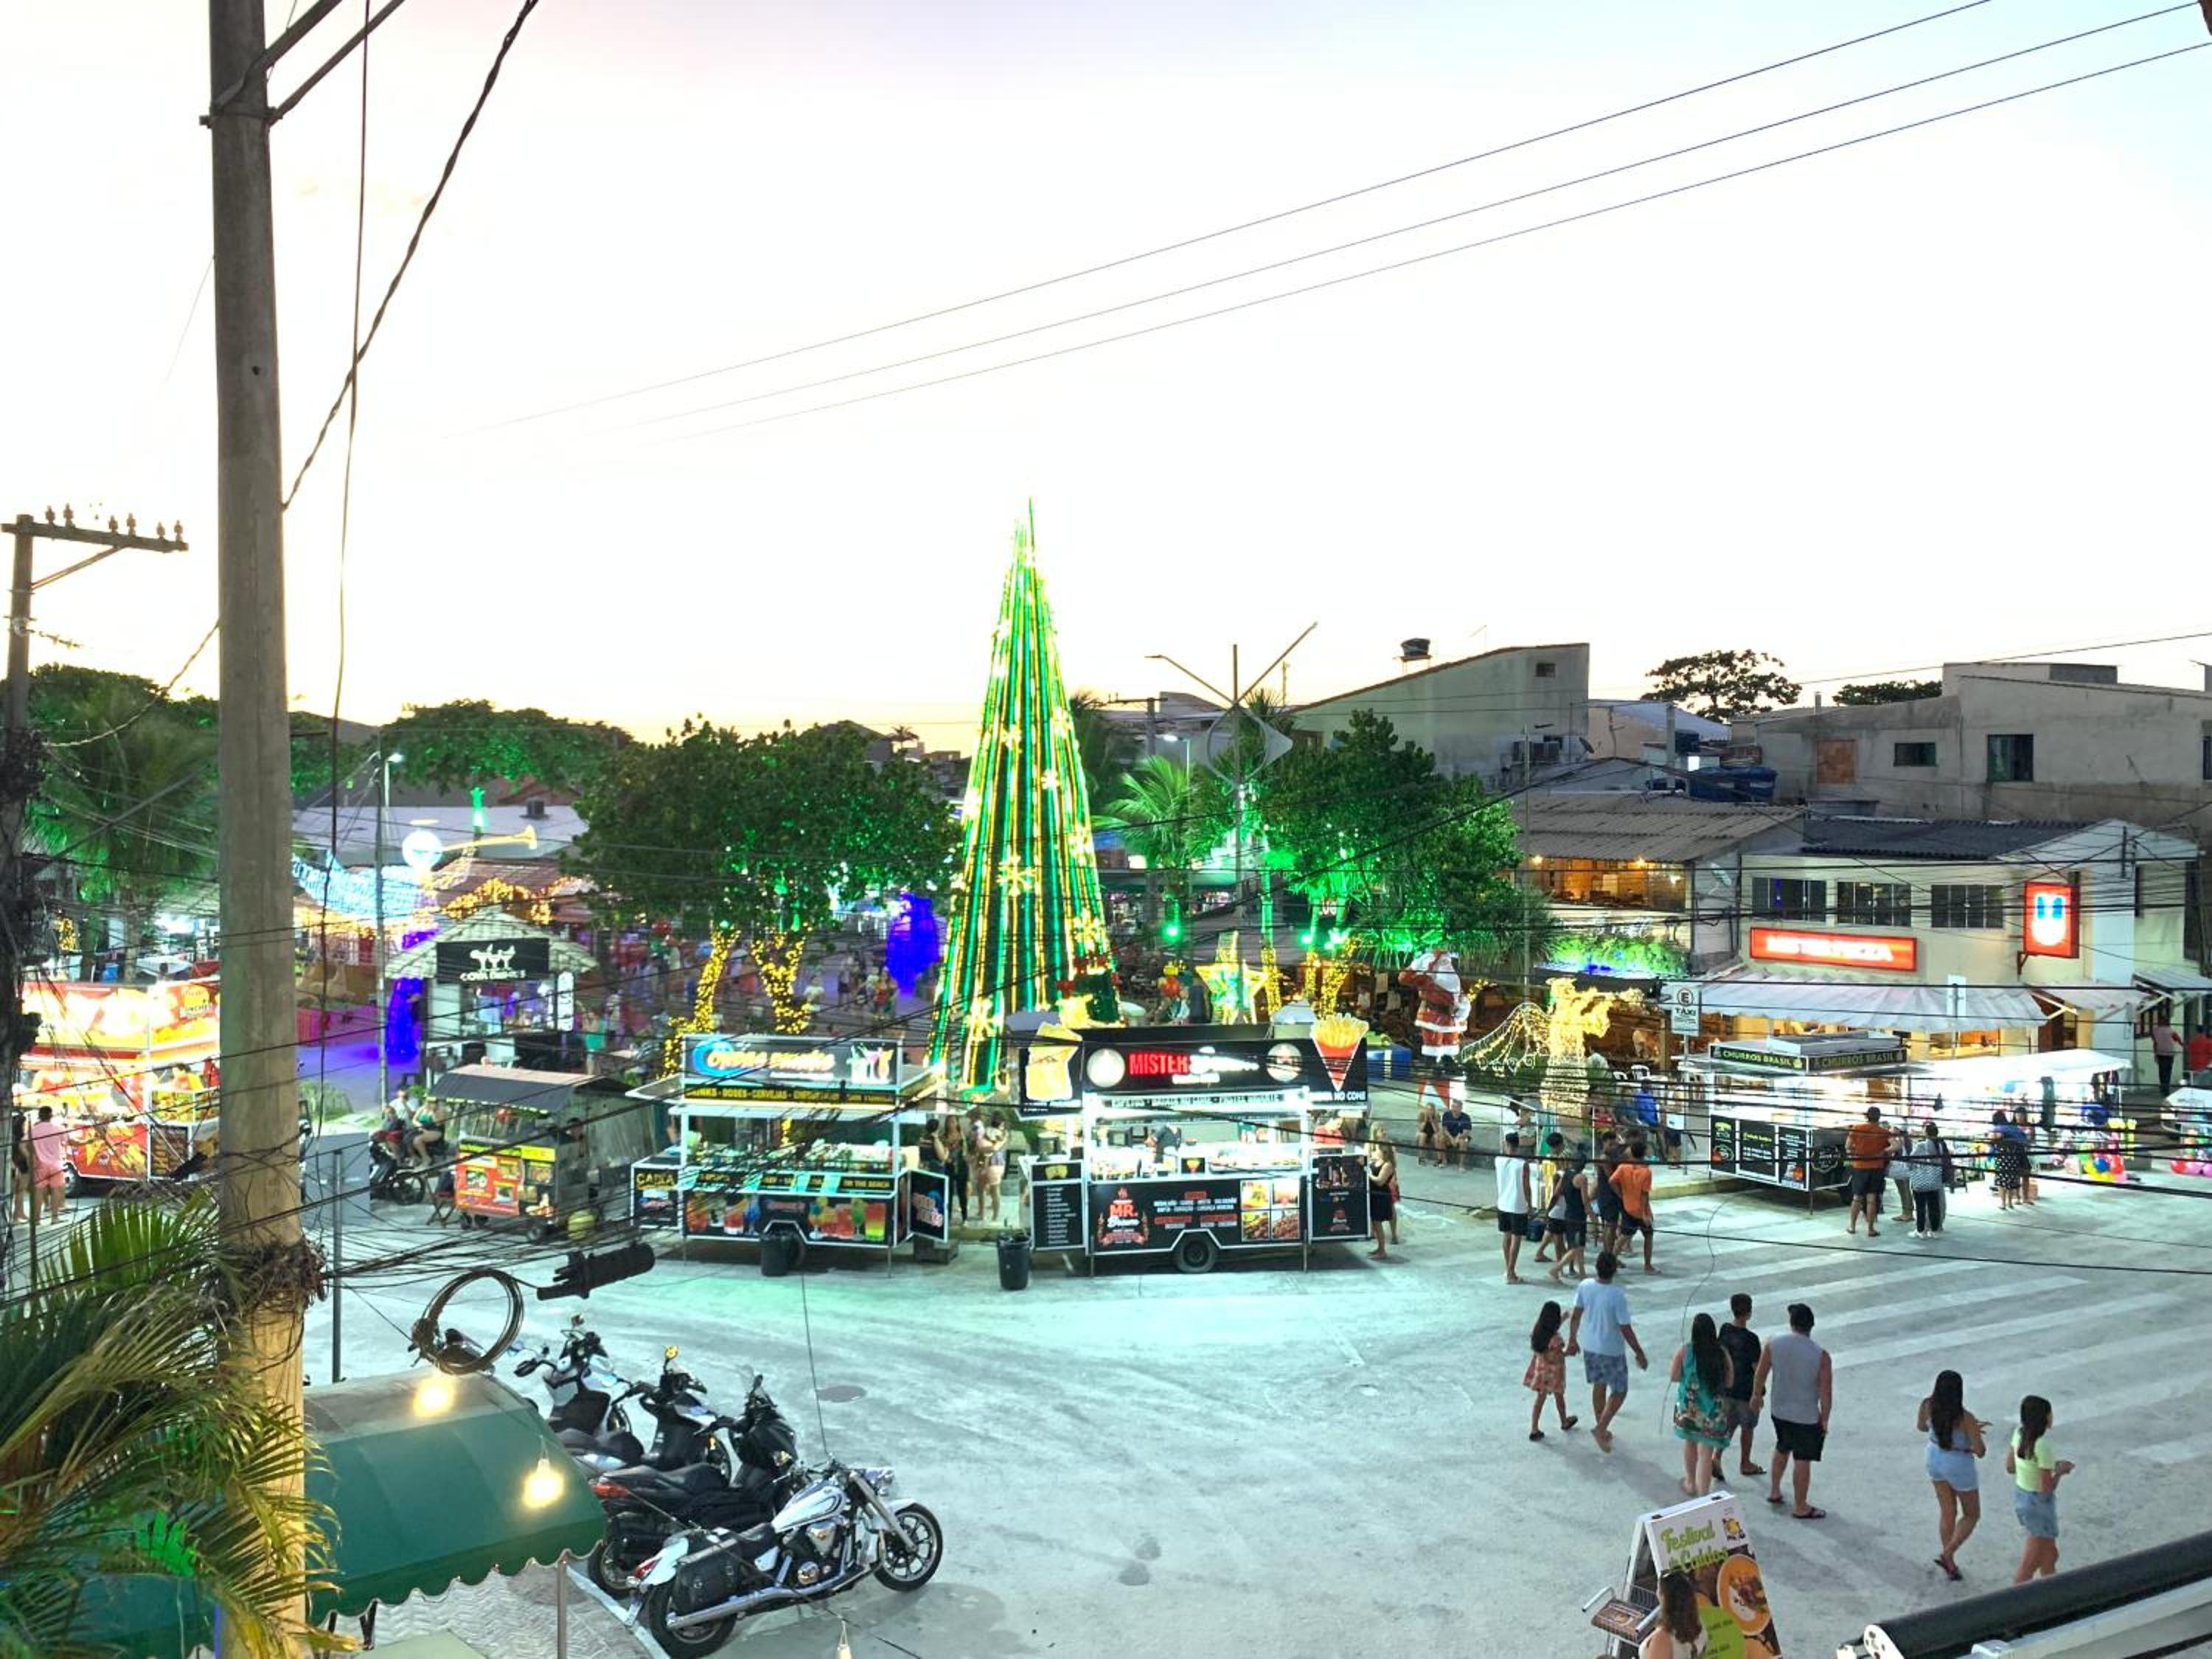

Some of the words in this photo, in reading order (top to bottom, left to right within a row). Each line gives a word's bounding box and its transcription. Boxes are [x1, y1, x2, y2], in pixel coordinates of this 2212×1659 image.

[1681, 992, 1689, 1004] E
[1129, 1053, 1190, 1076] MISTER
[1722, 1049, 1761, 1062] CHURROS
[1763, 1056, 1792, 1067] BRASIL
[1822, 1054, 1864, 1068] CHURROS
[1866, 1051, 1893, 1064] BRASIL
[1109, 1203, 1138, 1217] MR.
[1660, 1520, 1716, 1553] Festival
